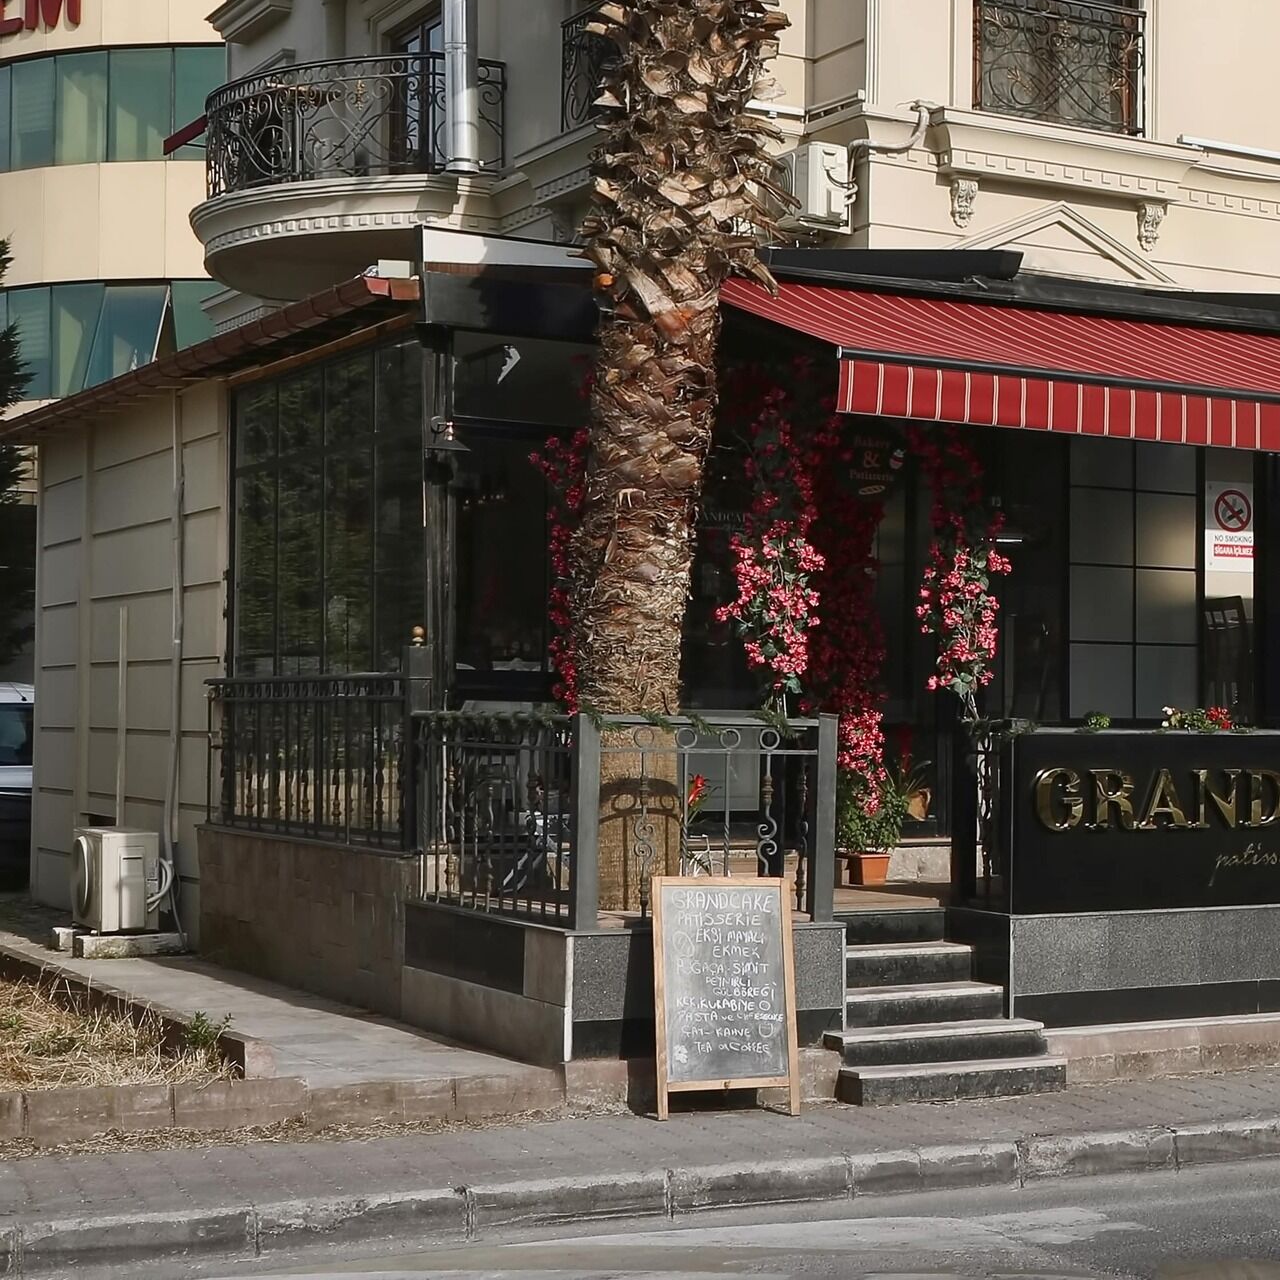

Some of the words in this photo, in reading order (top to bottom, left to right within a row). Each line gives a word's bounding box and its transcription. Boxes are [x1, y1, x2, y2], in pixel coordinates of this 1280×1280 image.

[1225, 535, 1253, 543] SMOKING
[671, 889, 773, 913] GRANDCAKE
[712, 945, 761, 959] EKMEK
[694, 1041, 713, 1056] TEA
